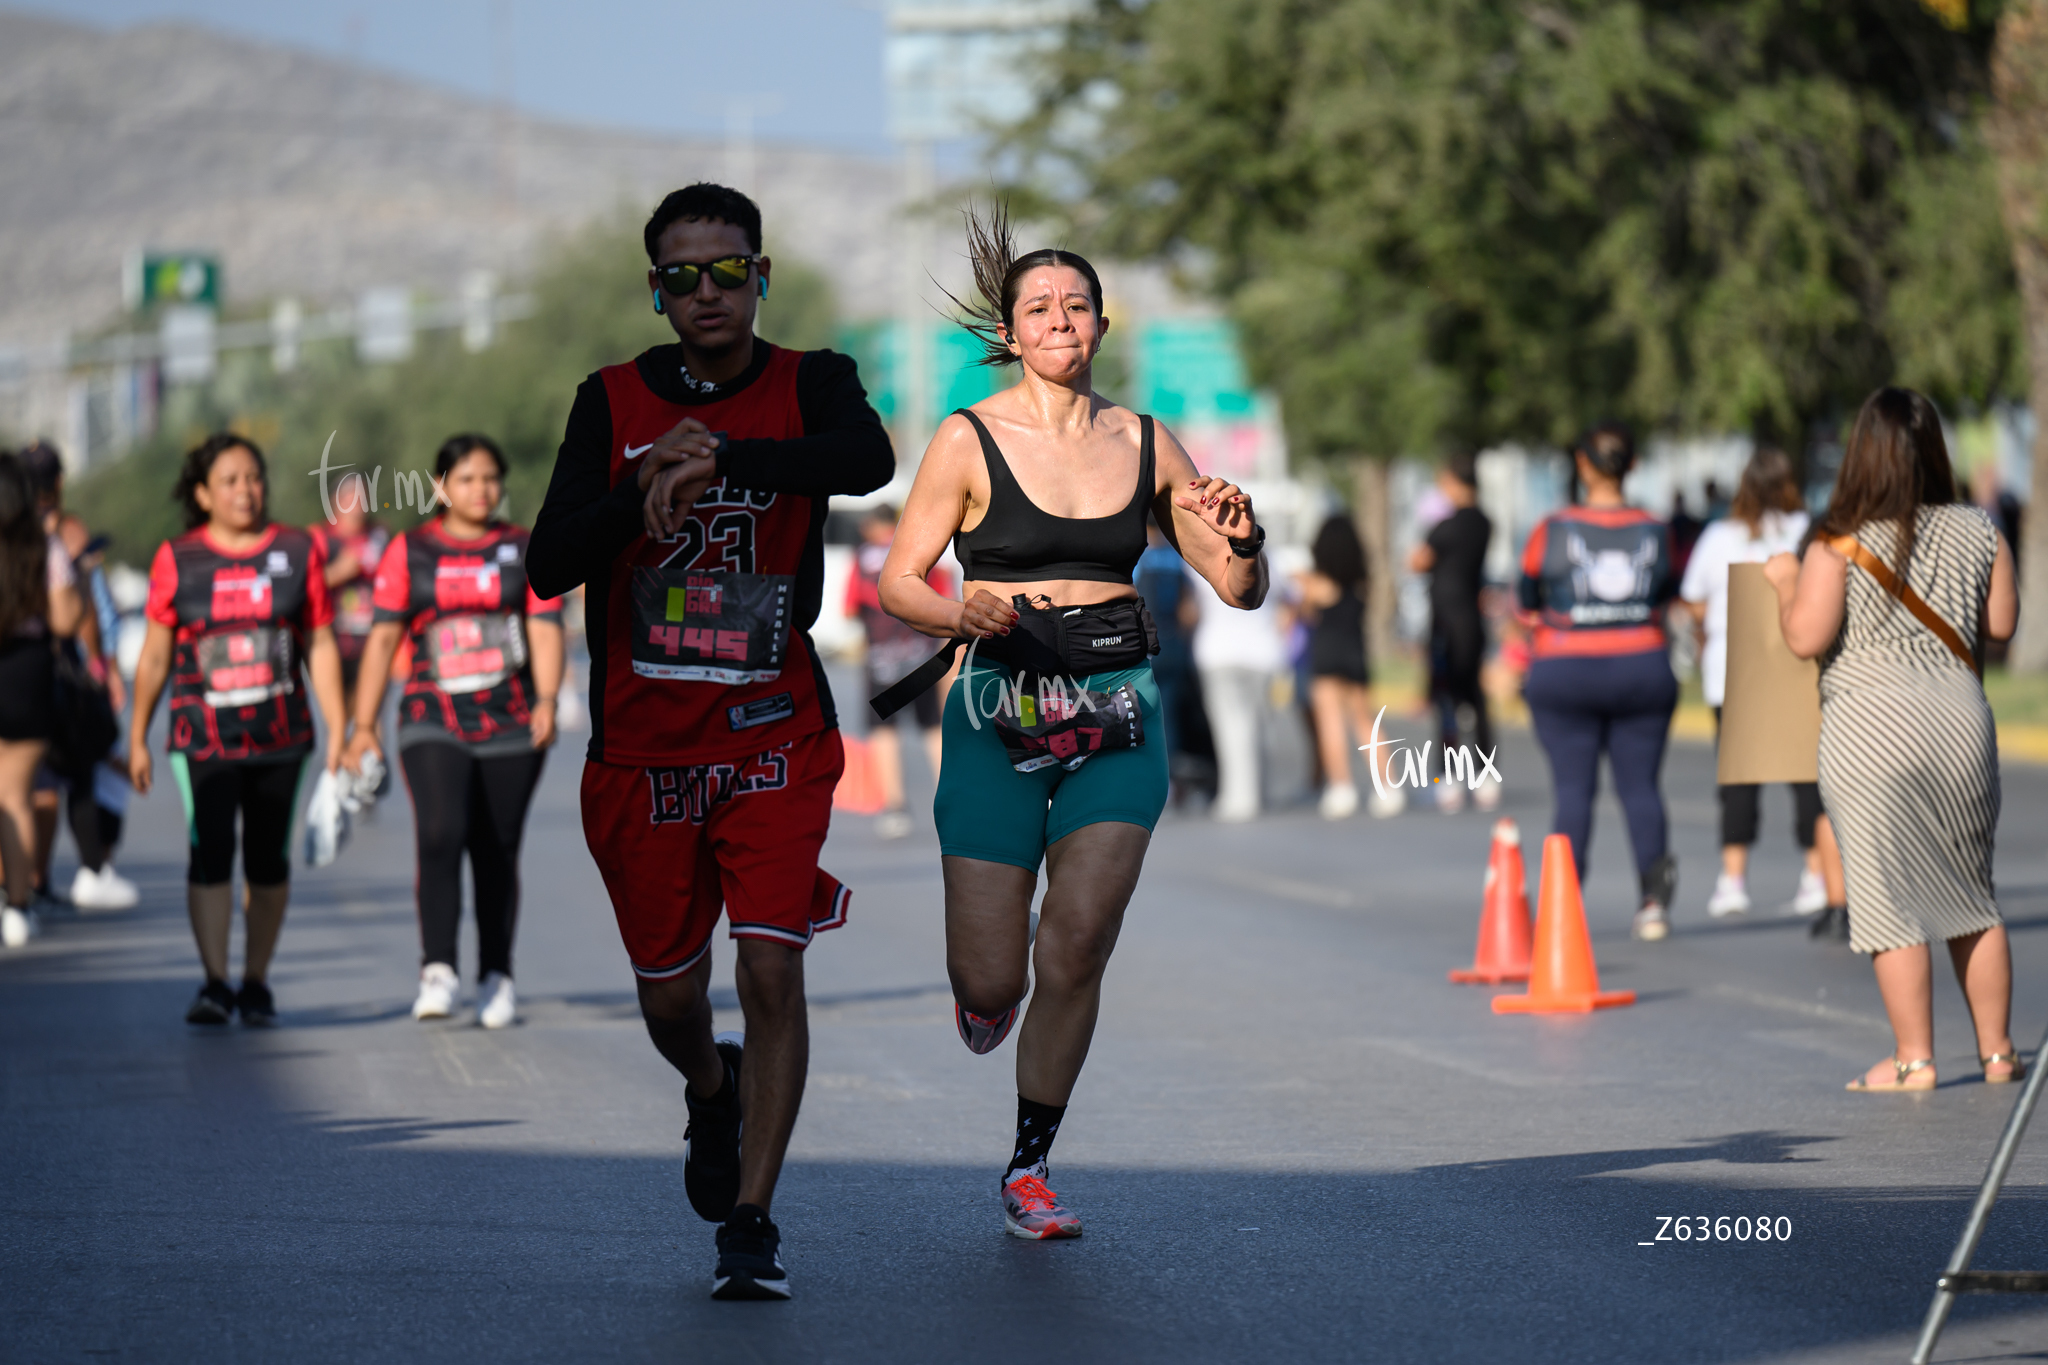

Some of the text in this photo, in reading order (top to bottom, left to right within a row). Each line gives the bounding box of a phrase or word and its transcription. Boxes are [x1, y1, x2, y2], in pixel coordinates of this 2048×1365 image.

[658, 510, 756, 574] 23
[648, 625, 749, 662] 445
[769, 584, 787, 664] MEDALLA
[1092, 636, 1122, 648] KIPRUN
